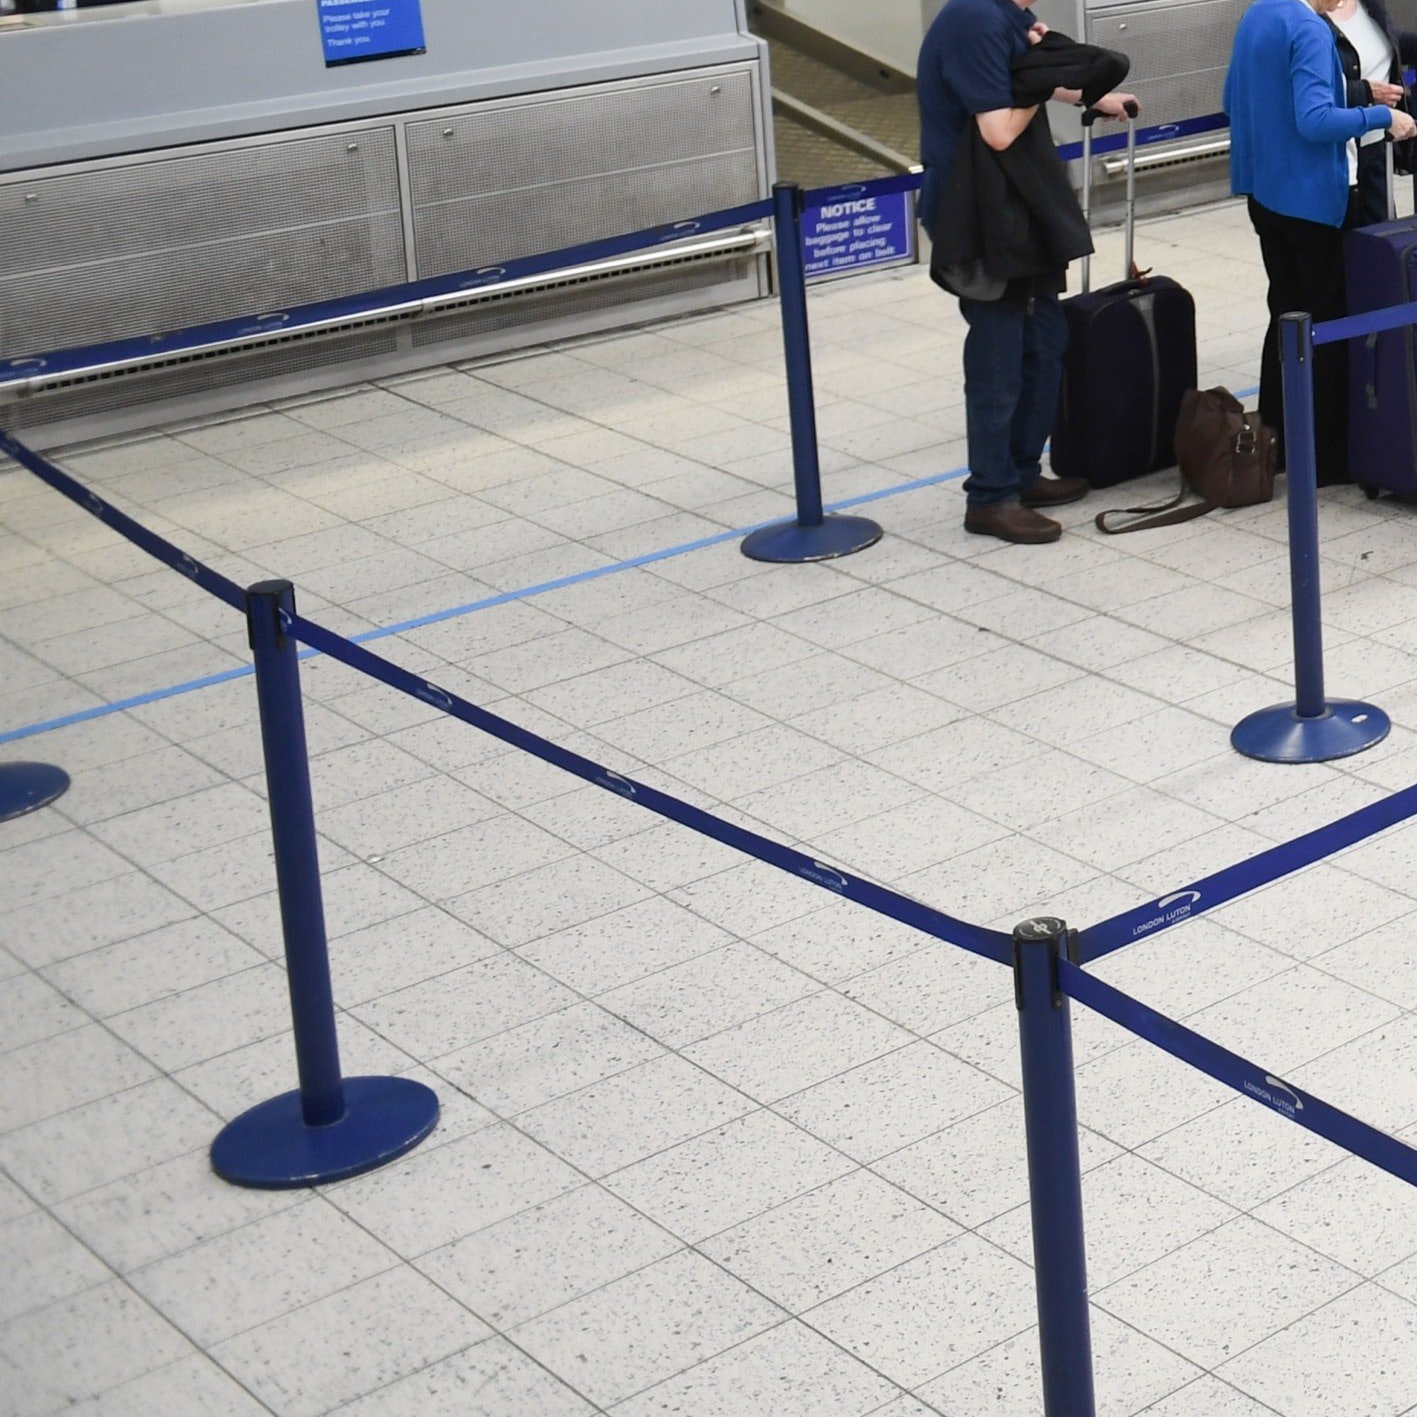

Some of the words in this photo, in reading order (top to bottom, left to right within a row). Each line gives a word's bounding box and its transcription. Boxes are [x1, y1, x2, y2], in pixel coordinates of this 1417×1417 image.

[323, 13, 352, 24] Please
[352, 11, 371, 20] take
[371, 8, 391, 20] your
[324, 24, 351, 34] trolley
[351, 20, 369, 30] with
[327, 37, 353, 48] Thank
[820, 197, 877, 220] NOTICE
[804, 230, 850, 247] baggage
[852, 227, 865, 238] to
[866, 222, 893, 235] clear
[815, 219, 851, 234] Please
[852, 214, 882, 227] allow
[804, 258, 830, 272] next
[831, 254, 857, 266] item
[858, 251, 874, 261] on
[874, 245, 897, 258] belt
[813, 244, 847, 259] before
[848, 236, 888, 254] placing
[1132, 914, 1165, 936] LONDON
[1165, 903, 1192, 920] LUTON
[1243, 1079, 1272, 1103] LONDON
[1271, 1096, 1295, 1115] LUTON
